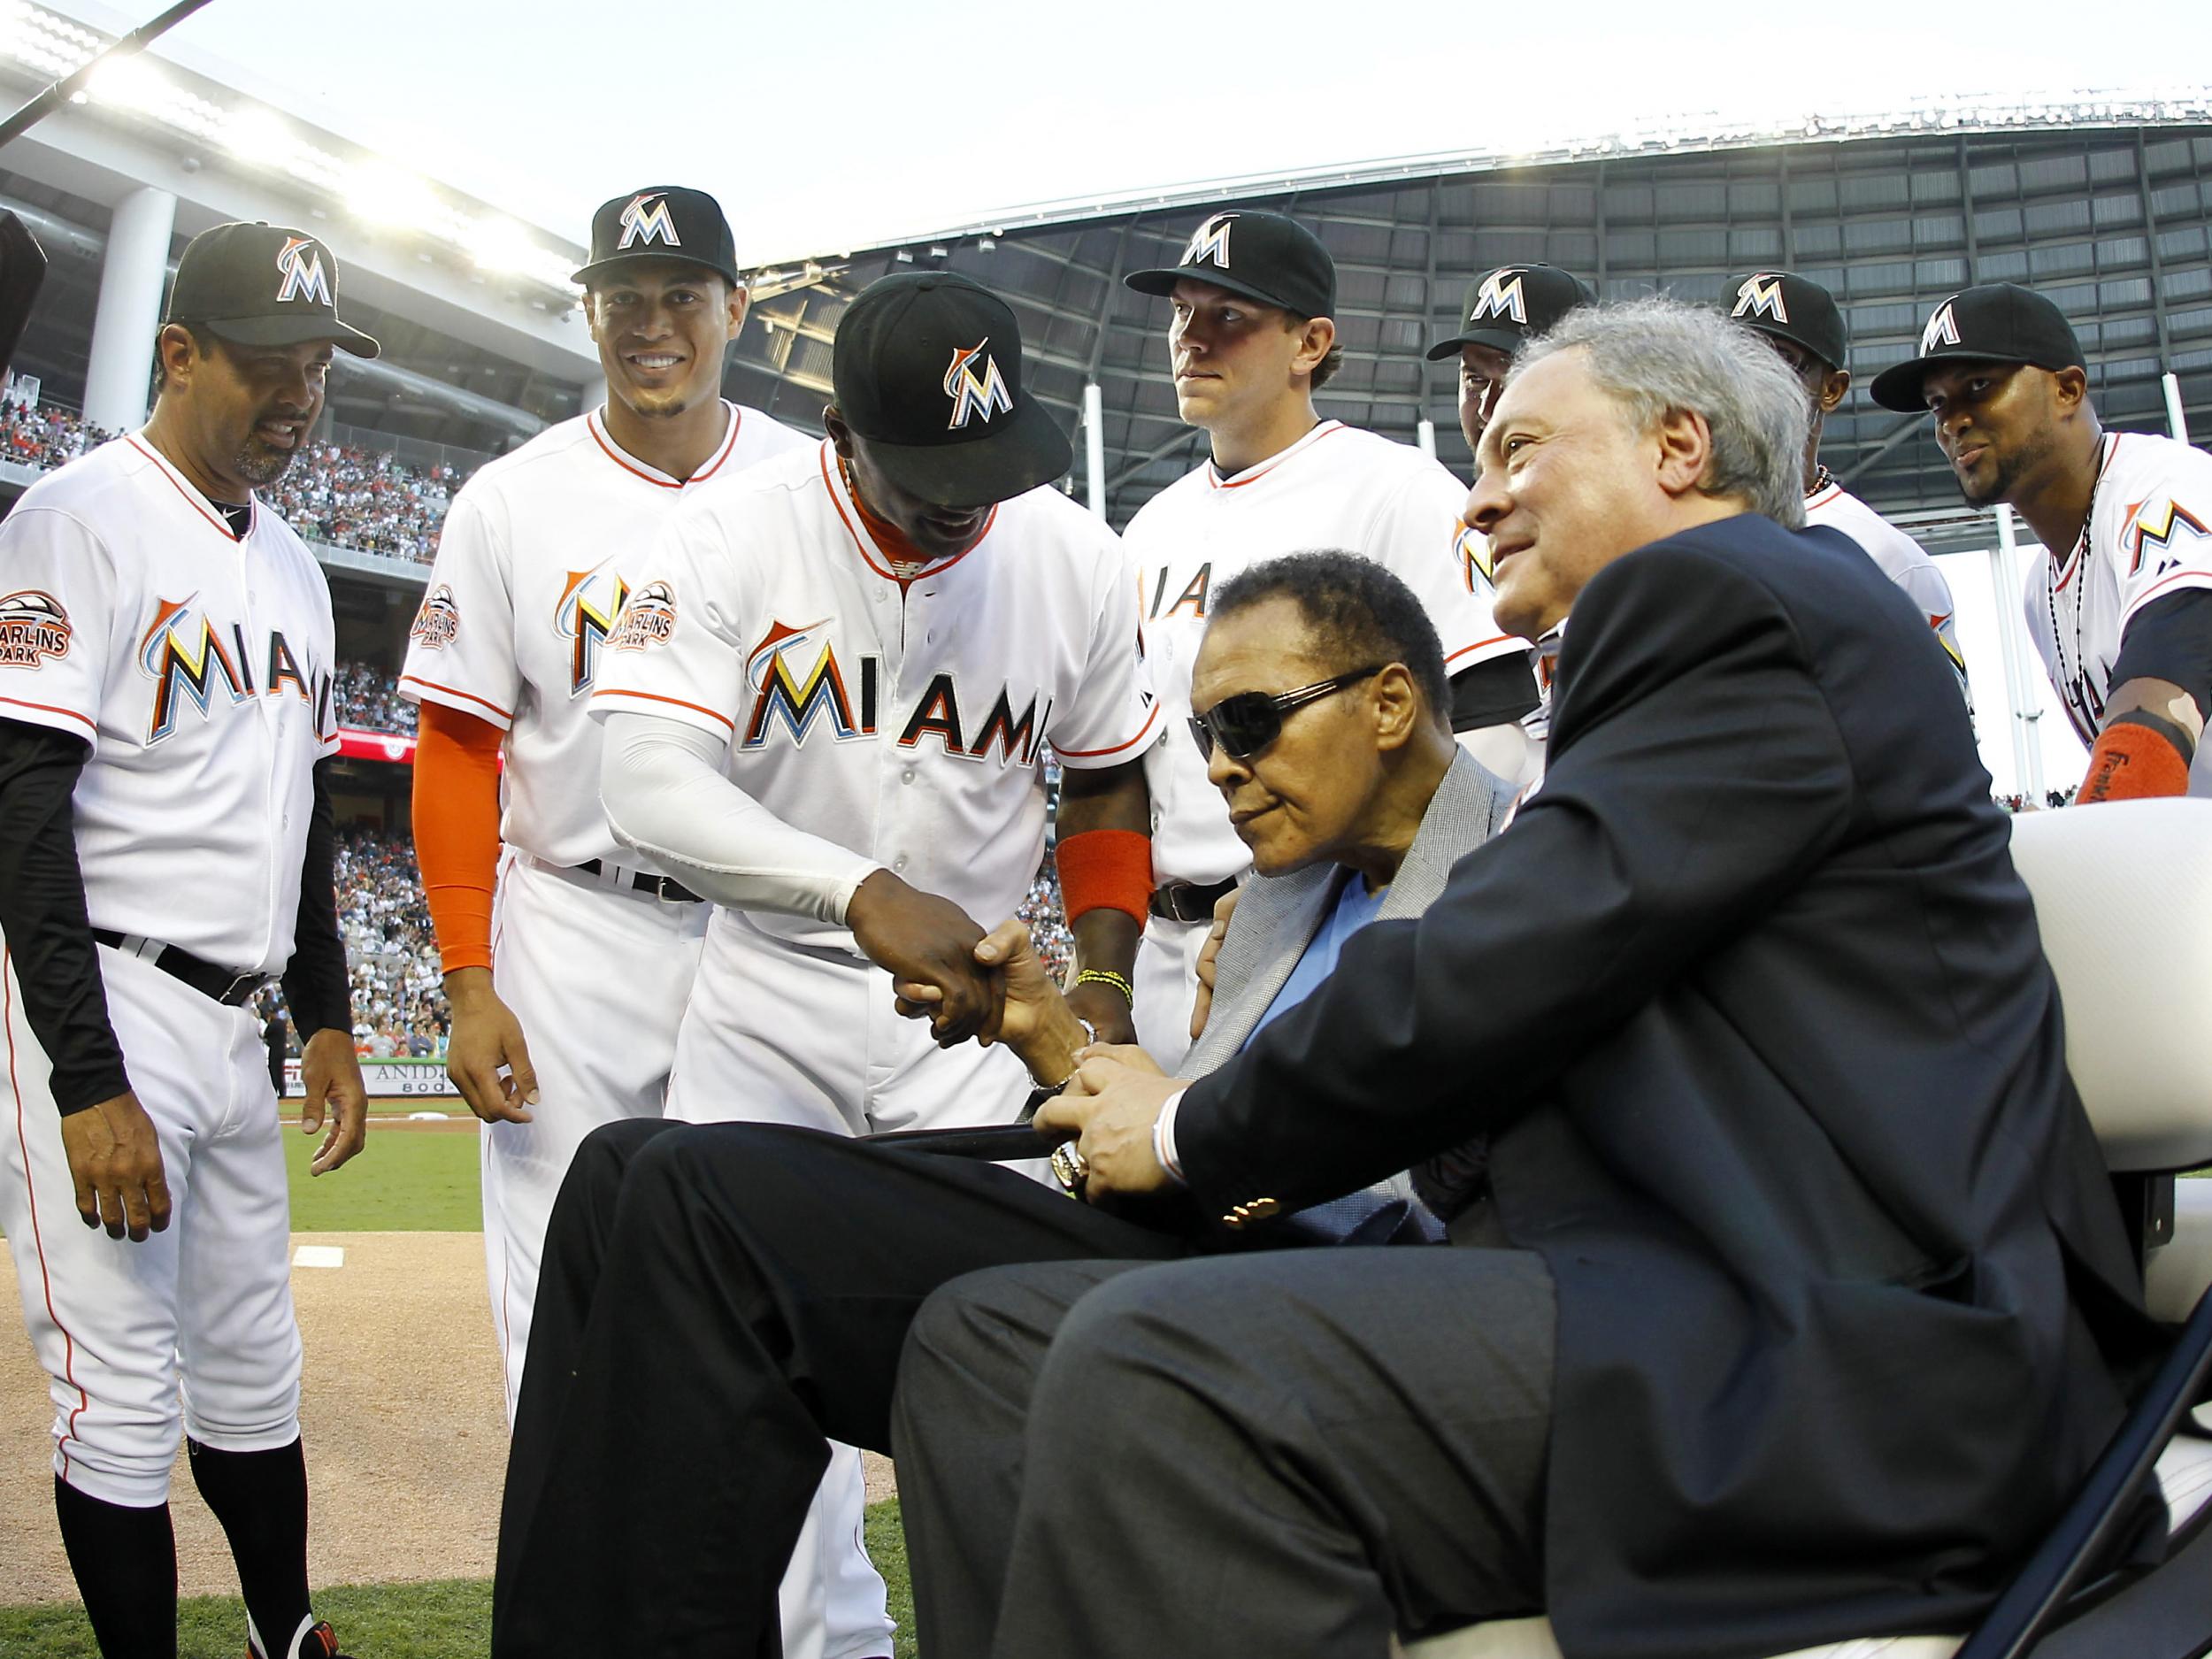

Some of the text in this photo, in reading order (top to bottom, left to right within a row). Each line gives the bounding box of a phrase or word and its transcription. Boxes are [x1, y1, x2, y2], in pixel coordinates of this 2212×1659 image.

[618, 196, 682, 250] M
[276, 244, 333, 308] M
[945, 349, 1013, 431] M
[0, 625, 65, 651] ARLINS
[0, 647, 36, 663] ARK
